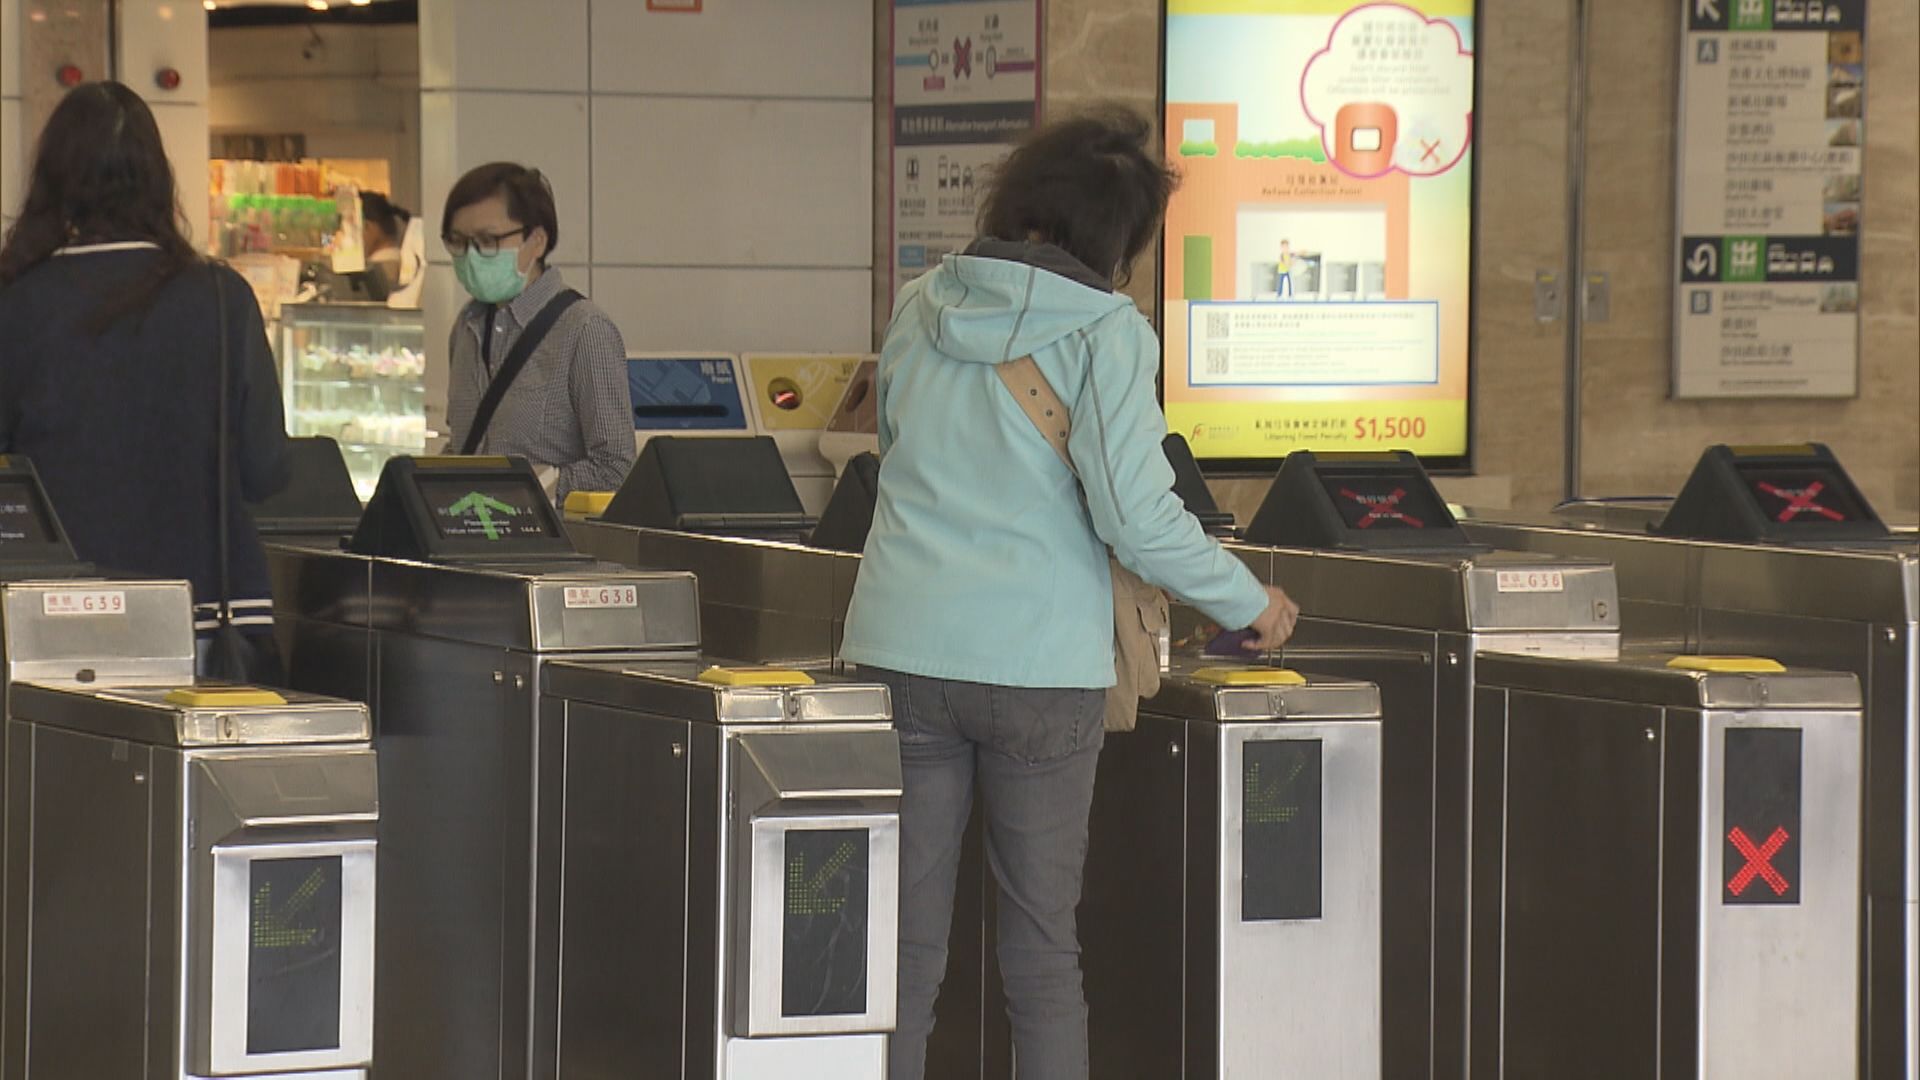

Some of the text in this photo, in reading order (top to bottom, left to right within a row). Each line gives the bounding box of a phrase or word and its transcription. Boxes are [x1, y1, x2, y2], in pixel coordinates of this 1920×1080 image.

[1701, 41, 1715, 61] A
[1731, 240, 1757, 266] 出
[1695, 292, 1707, 311] B
[1353, 416, 1427, 442] $1,500
[83, 595, 121, 611] G39
[600, 589, 634, 604] G38
